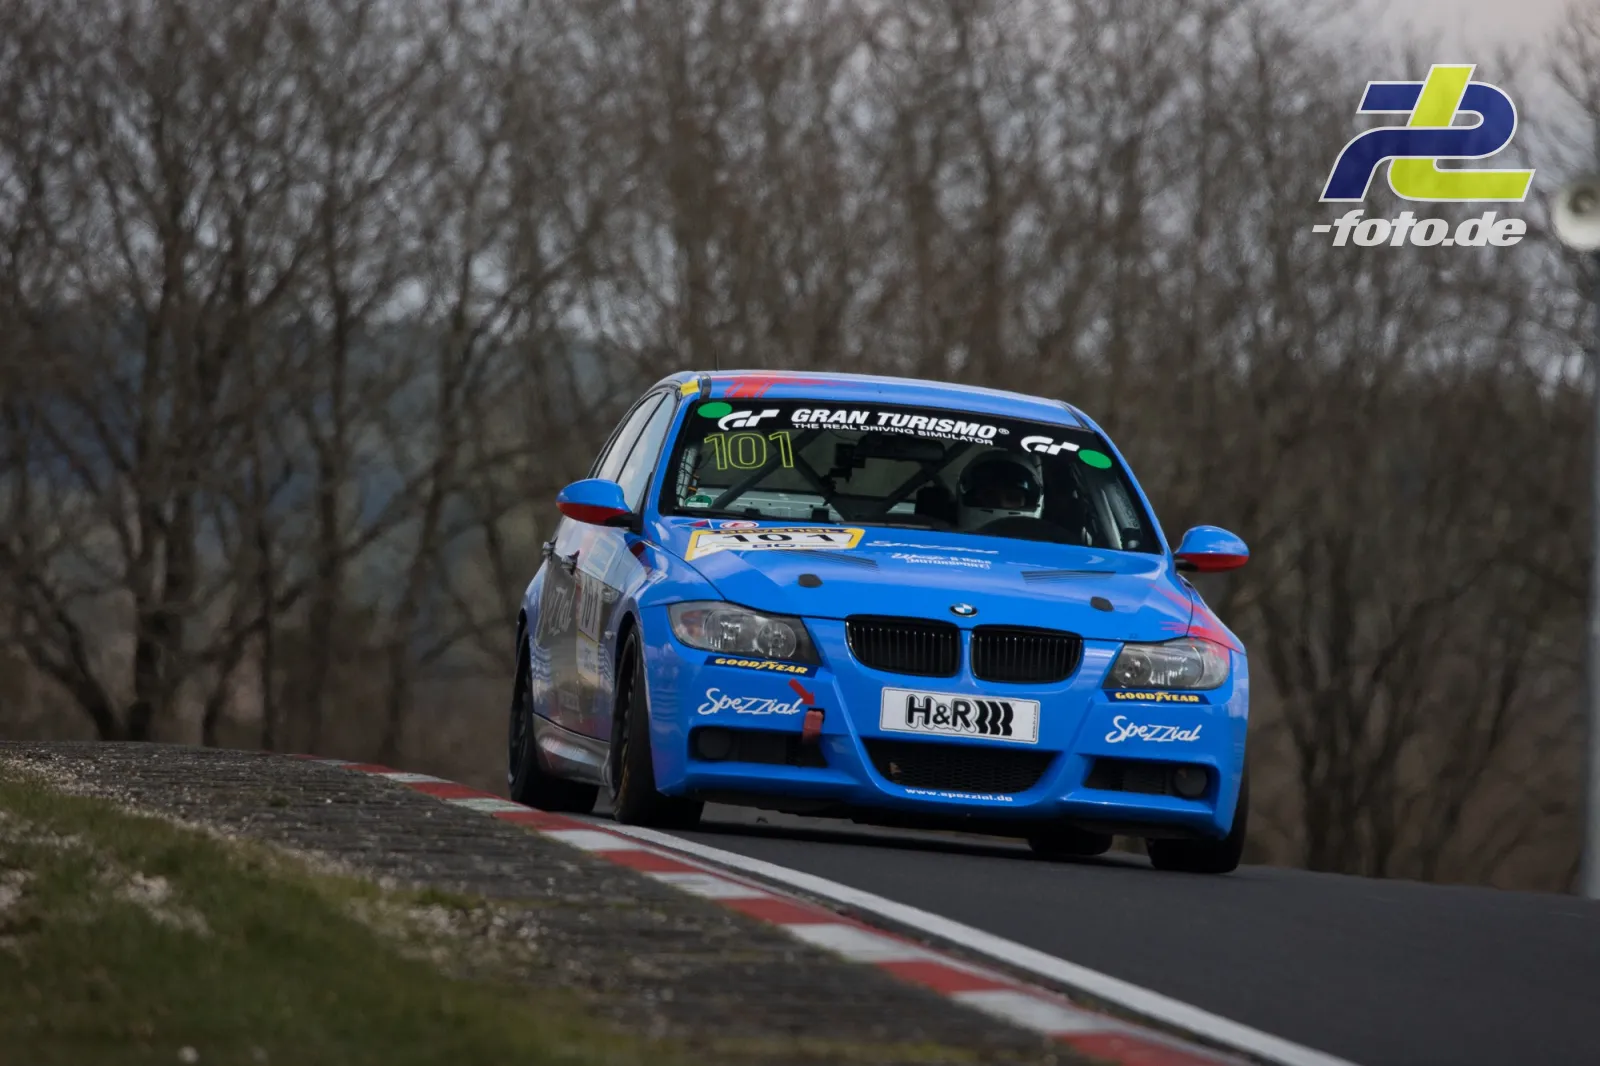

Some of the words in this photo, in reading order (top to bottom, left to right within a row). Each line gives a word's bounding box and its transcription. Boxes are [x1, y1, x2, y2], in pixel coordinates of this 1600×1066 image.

[791, 408, 869, 426] GRAN
[823, 423, 857, 431] REAL
[860, 426, 914, 435] DRIVING
[917, 430, 994, 446] SIMULATOR
[704, 431, 794, 471] 101
[723, 533, 835, 543] 101
[715, 656, 809, 675] GOODYEAR
[1115, 691, 1199, 703] GOODYEAR
[906, 694, 973, 731] H&R
[905, 788, 1013, 802] www.spezzial.de
